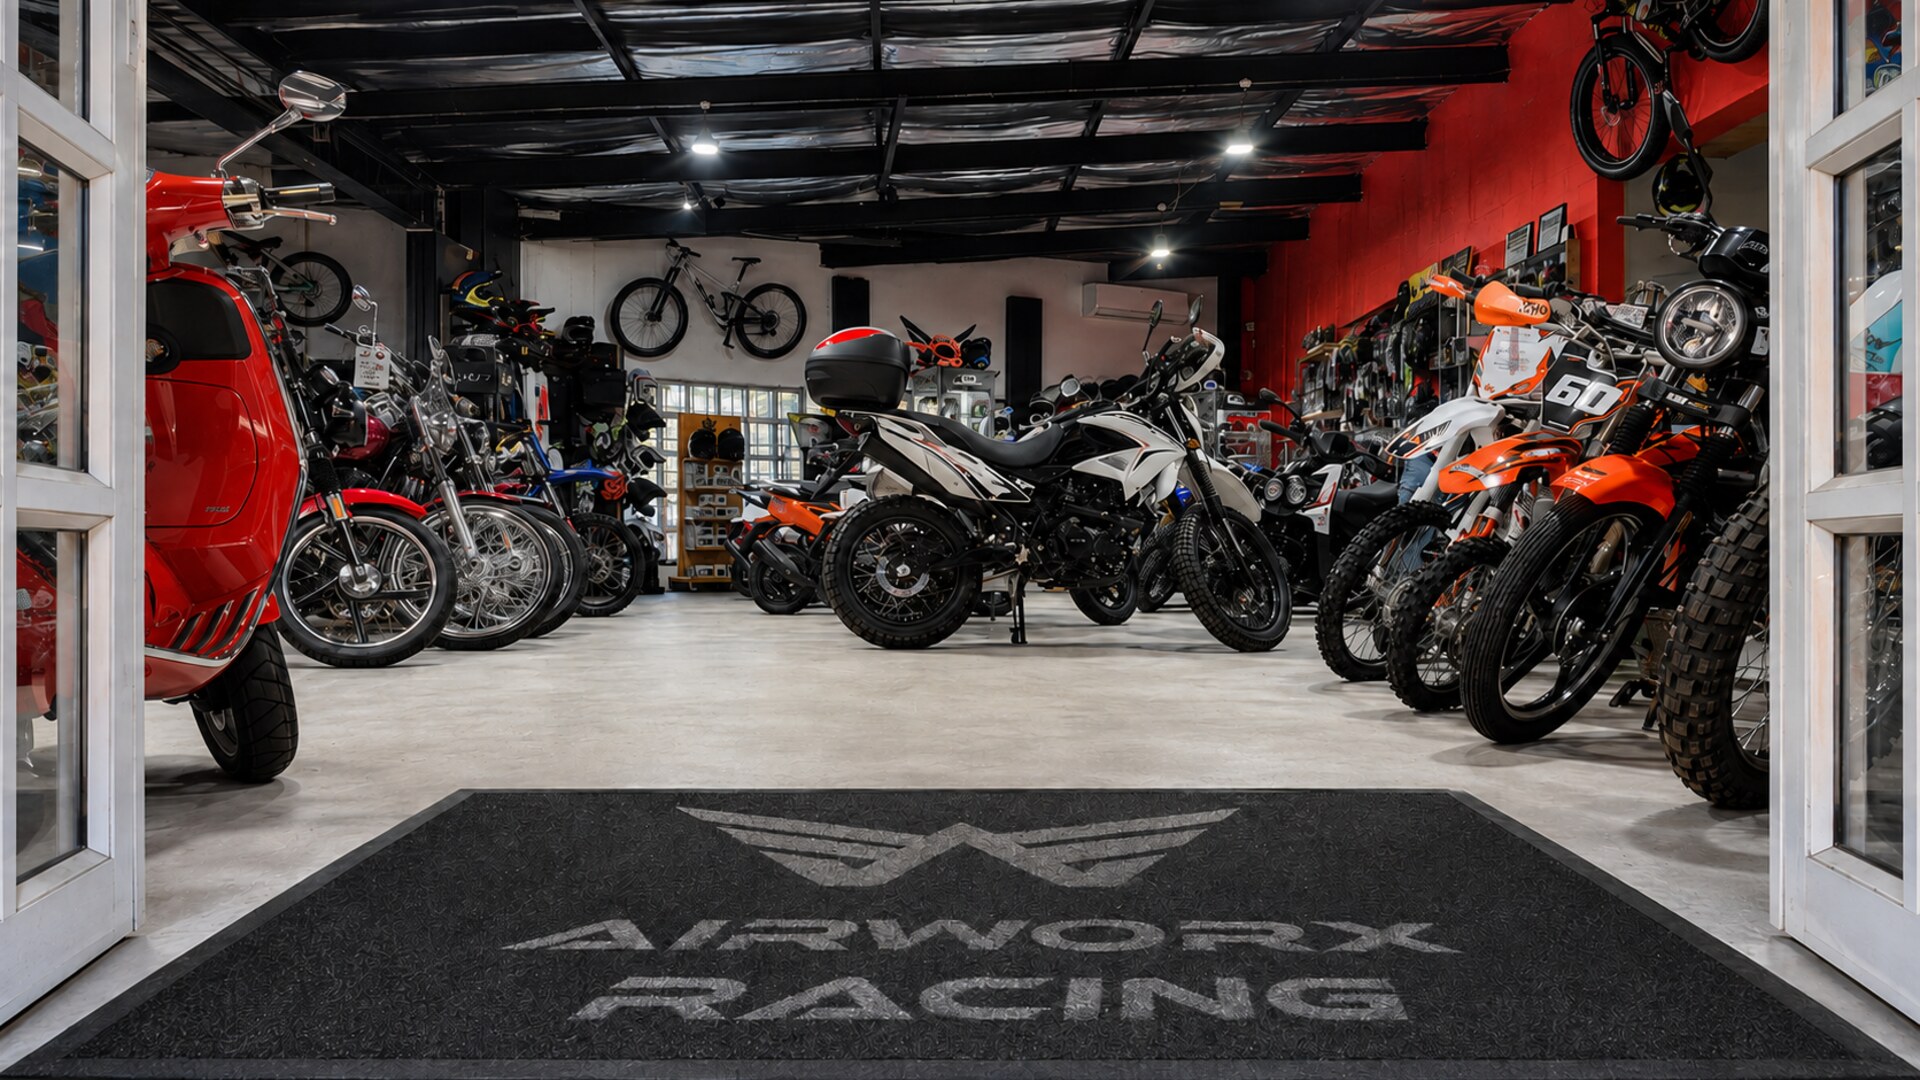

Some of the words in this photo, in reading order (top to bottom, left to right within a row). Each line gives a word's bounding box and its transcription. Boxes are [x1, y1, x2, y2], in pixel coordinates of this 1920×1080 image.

[1545, 373, 1624, 416] 60
[501, 919, 1464, 954] AIRWORX
[567, 976, 1409, 1021] RACING
